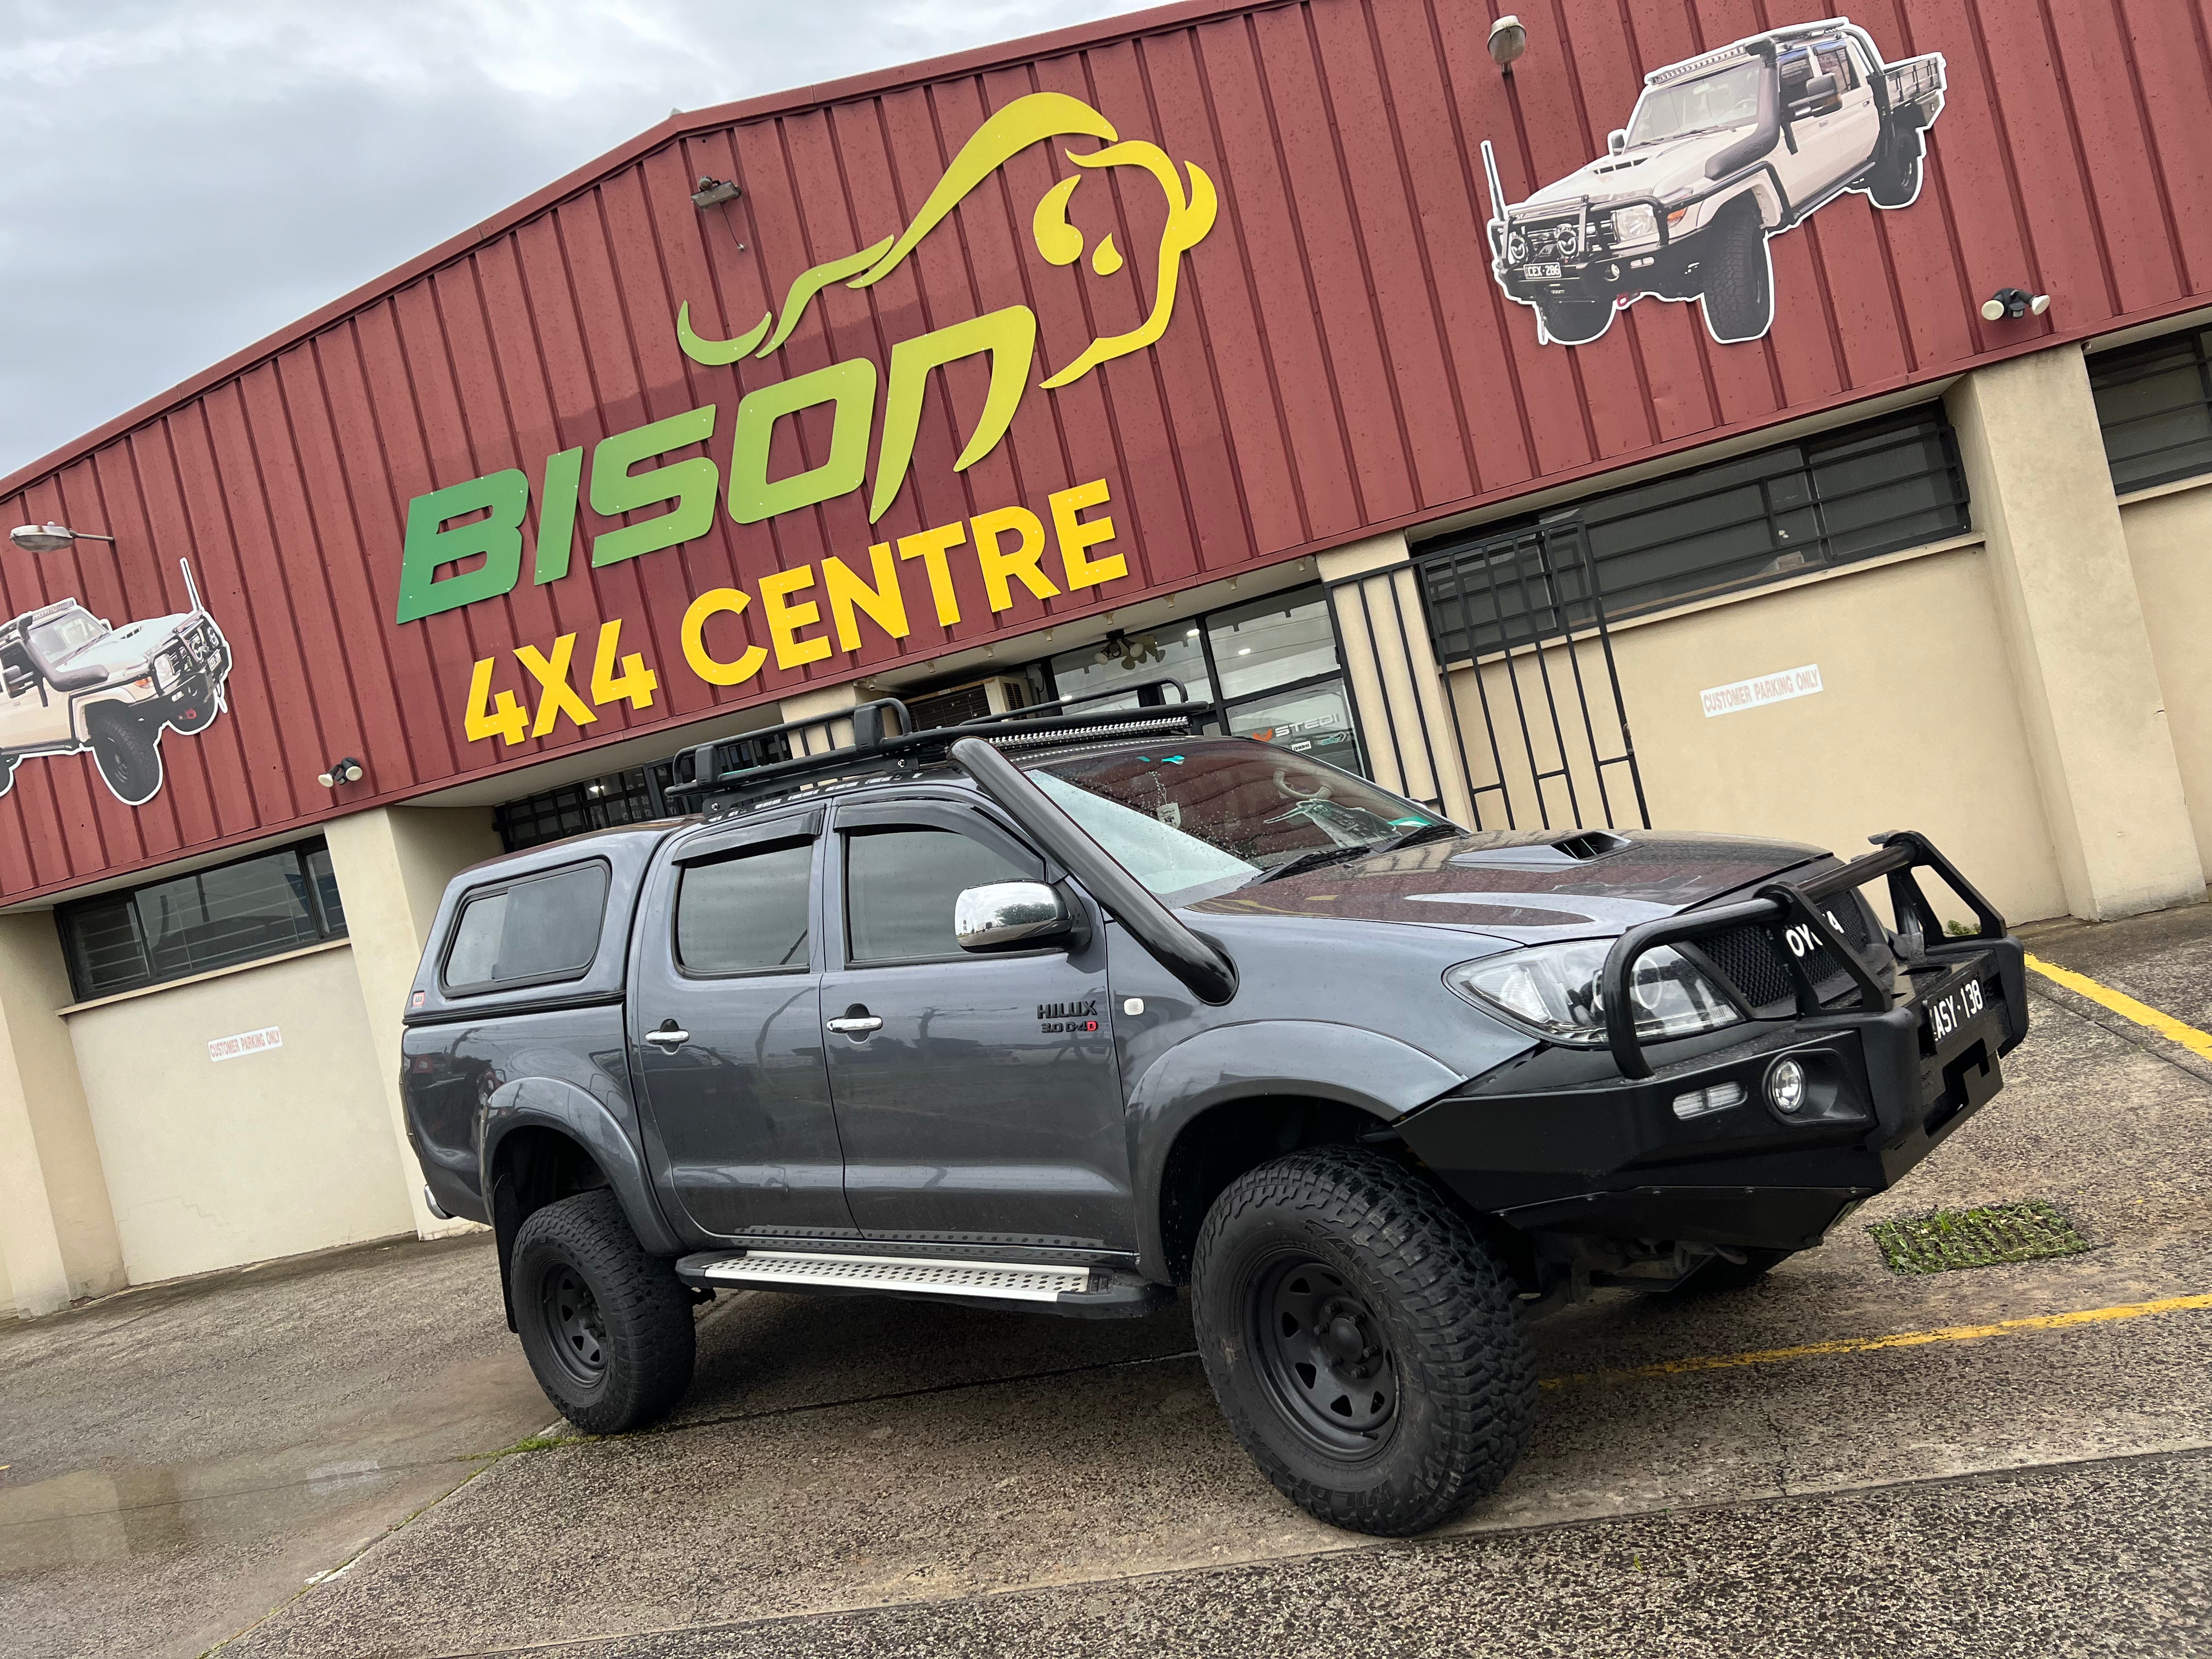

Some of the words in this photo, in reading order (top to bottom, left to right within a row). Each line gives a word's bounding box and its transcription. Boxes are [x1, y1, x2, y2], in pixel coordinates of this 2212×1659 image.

[464, 618, 658, 746] 4X4
[680, 477, 1128, 686] CENTRE
[1703, 686, 1752, 712] CUSTOMER
[1753, 676, 1793, 700] PARKING
[1796, 669, 1819, 691] ONLY
[1274, 714, 1338, 737] STEDI
[1037, 1000, 1097, 1019] HILUX
[210, 1039, 240, 1057] CUSTOMER
[241, 1033, 266, 1051] PARKING
[266, 1030, 280, 1045] ONLY
